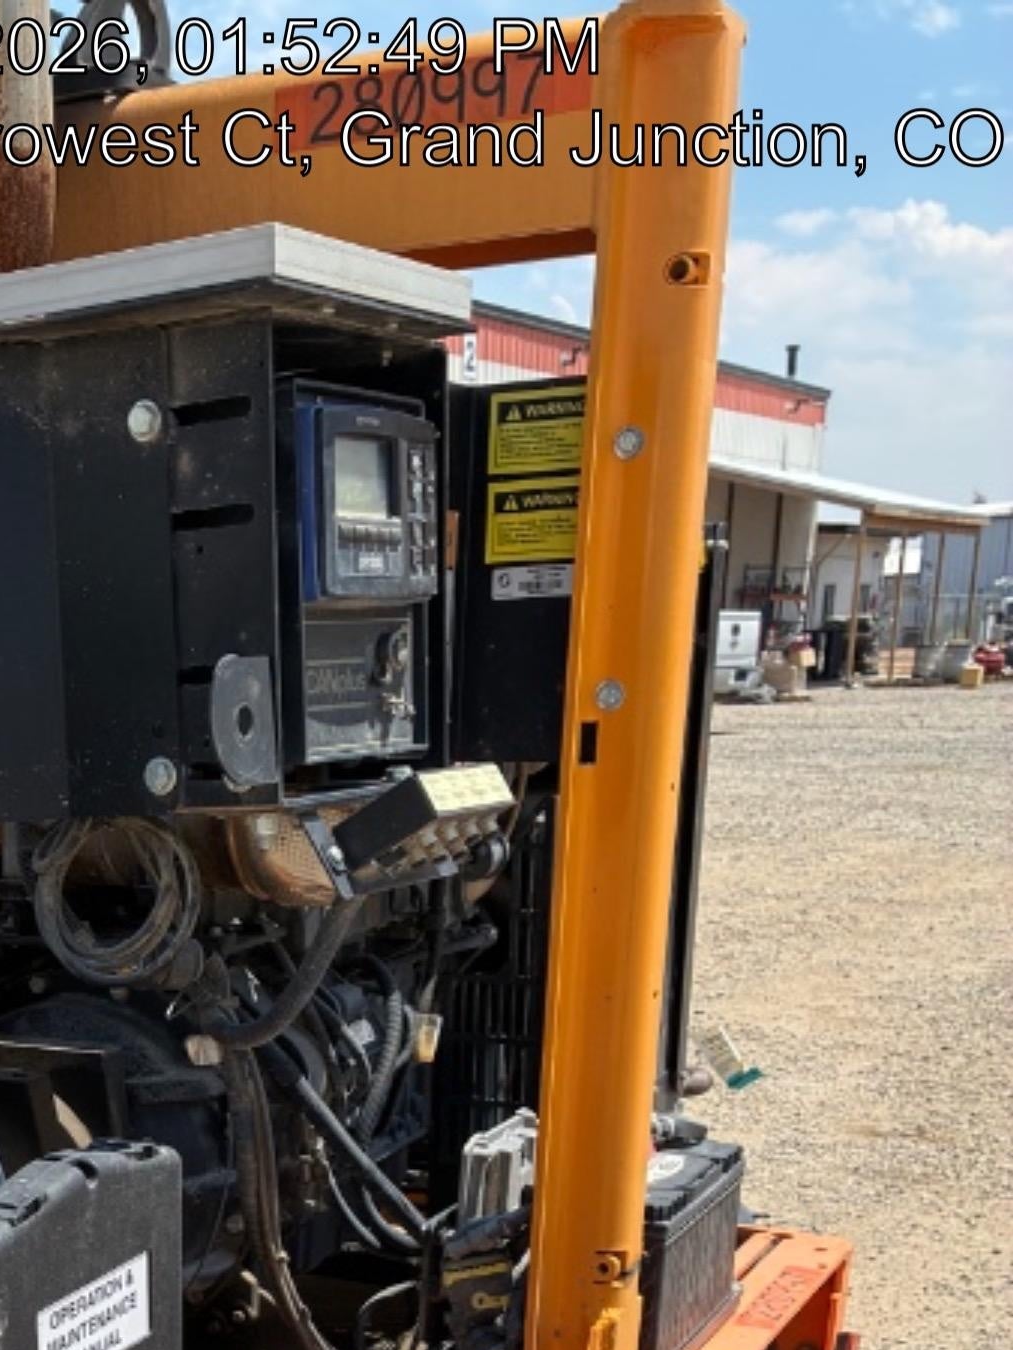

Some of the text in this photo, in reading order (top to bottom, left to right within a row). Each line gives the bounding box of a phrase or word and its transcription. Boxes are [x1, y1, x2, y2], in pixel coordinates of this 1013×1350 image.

[309, 47, 546, 145] 280997
[465, 341, 476, 373] 2
[524, 400, 583, 418] WARNIN
[521, 492, 579, 509] WARNIN
[49, 1275, 123, 1330] OPERATION
